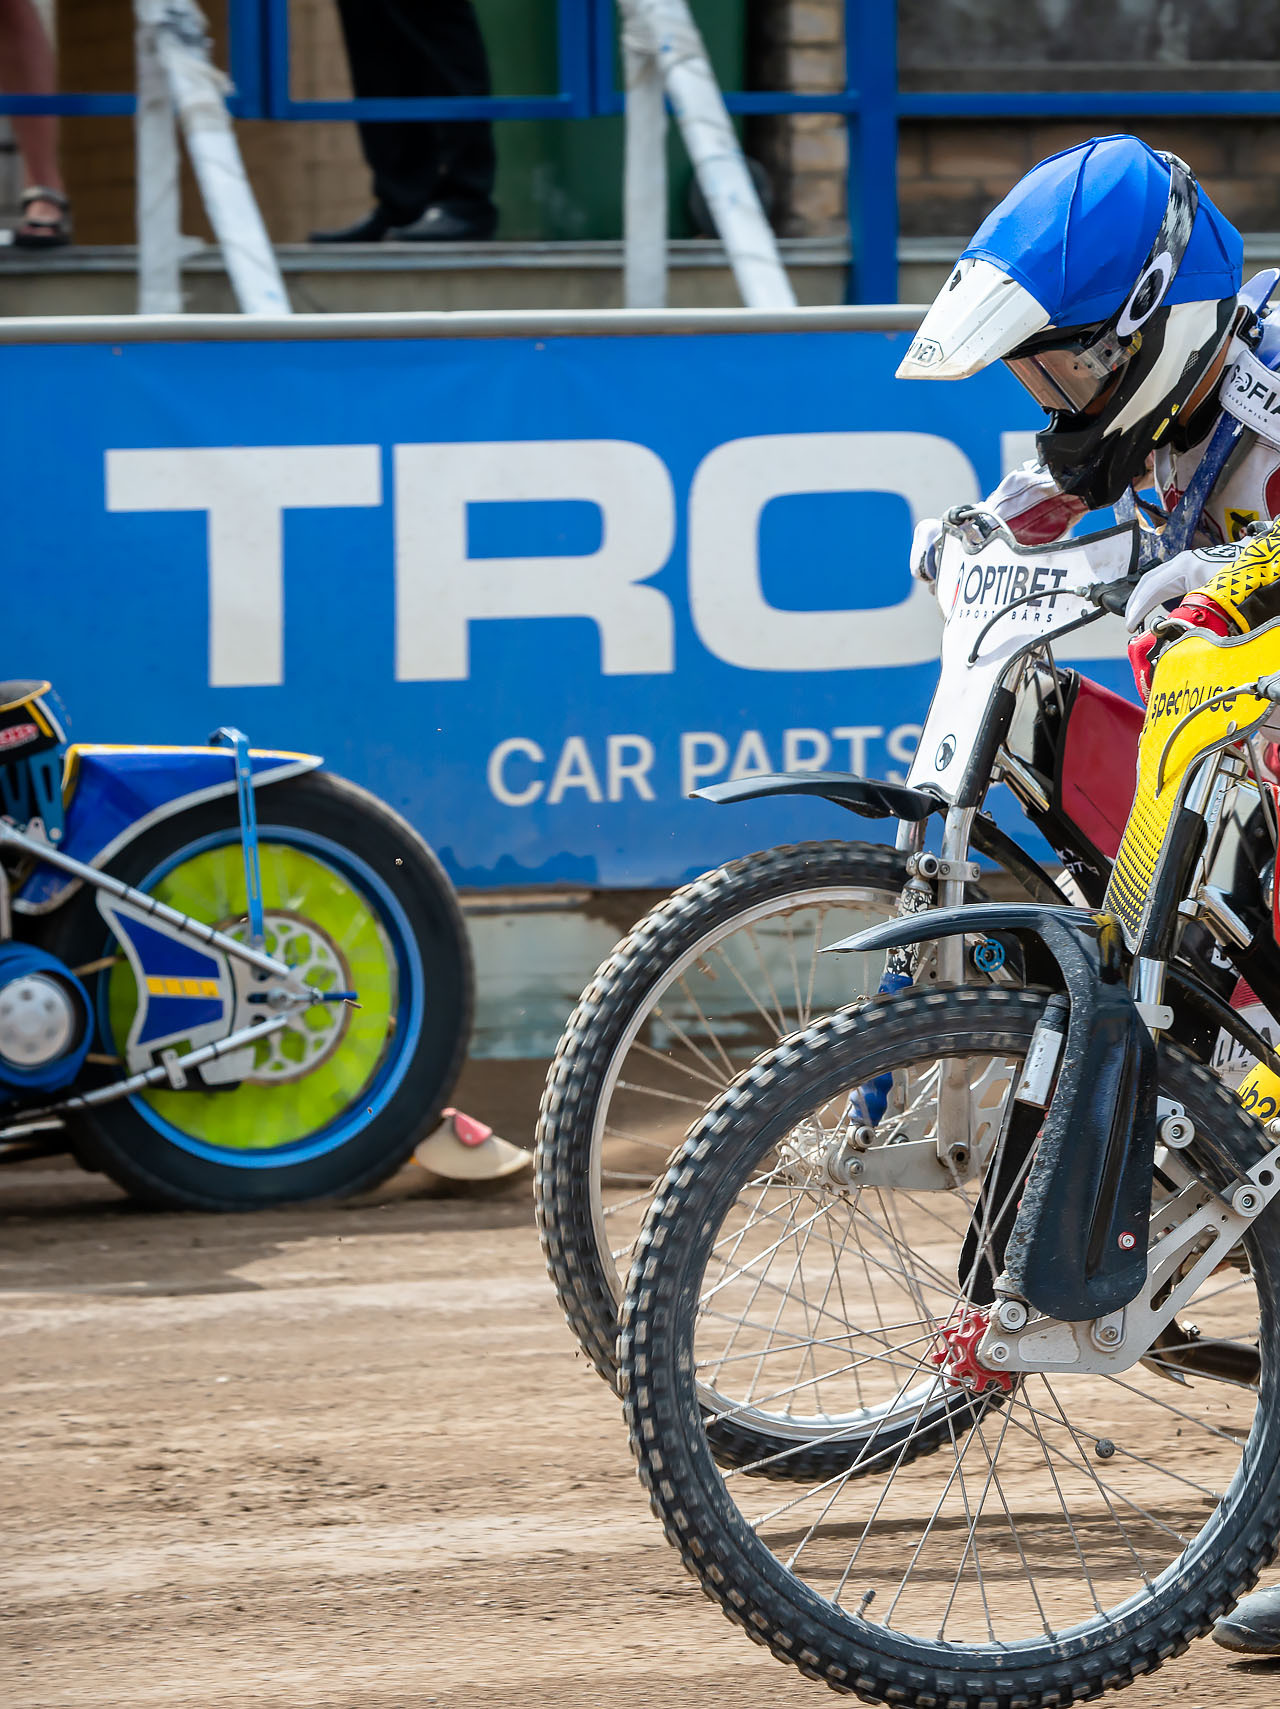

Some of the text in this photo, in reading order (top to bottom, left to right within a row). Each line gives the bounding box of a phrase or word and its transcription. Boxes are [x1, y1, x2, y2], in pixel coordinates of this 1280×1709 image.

[105, 430, 1060, 688] TRO
[963, 564, 1068, 609] OPTIBET
[959, 609, 1054, 623] SPORT BĀRS
[1151, 679, 1237, 728] spechouse
[487, 737, 656, 806] CAR
